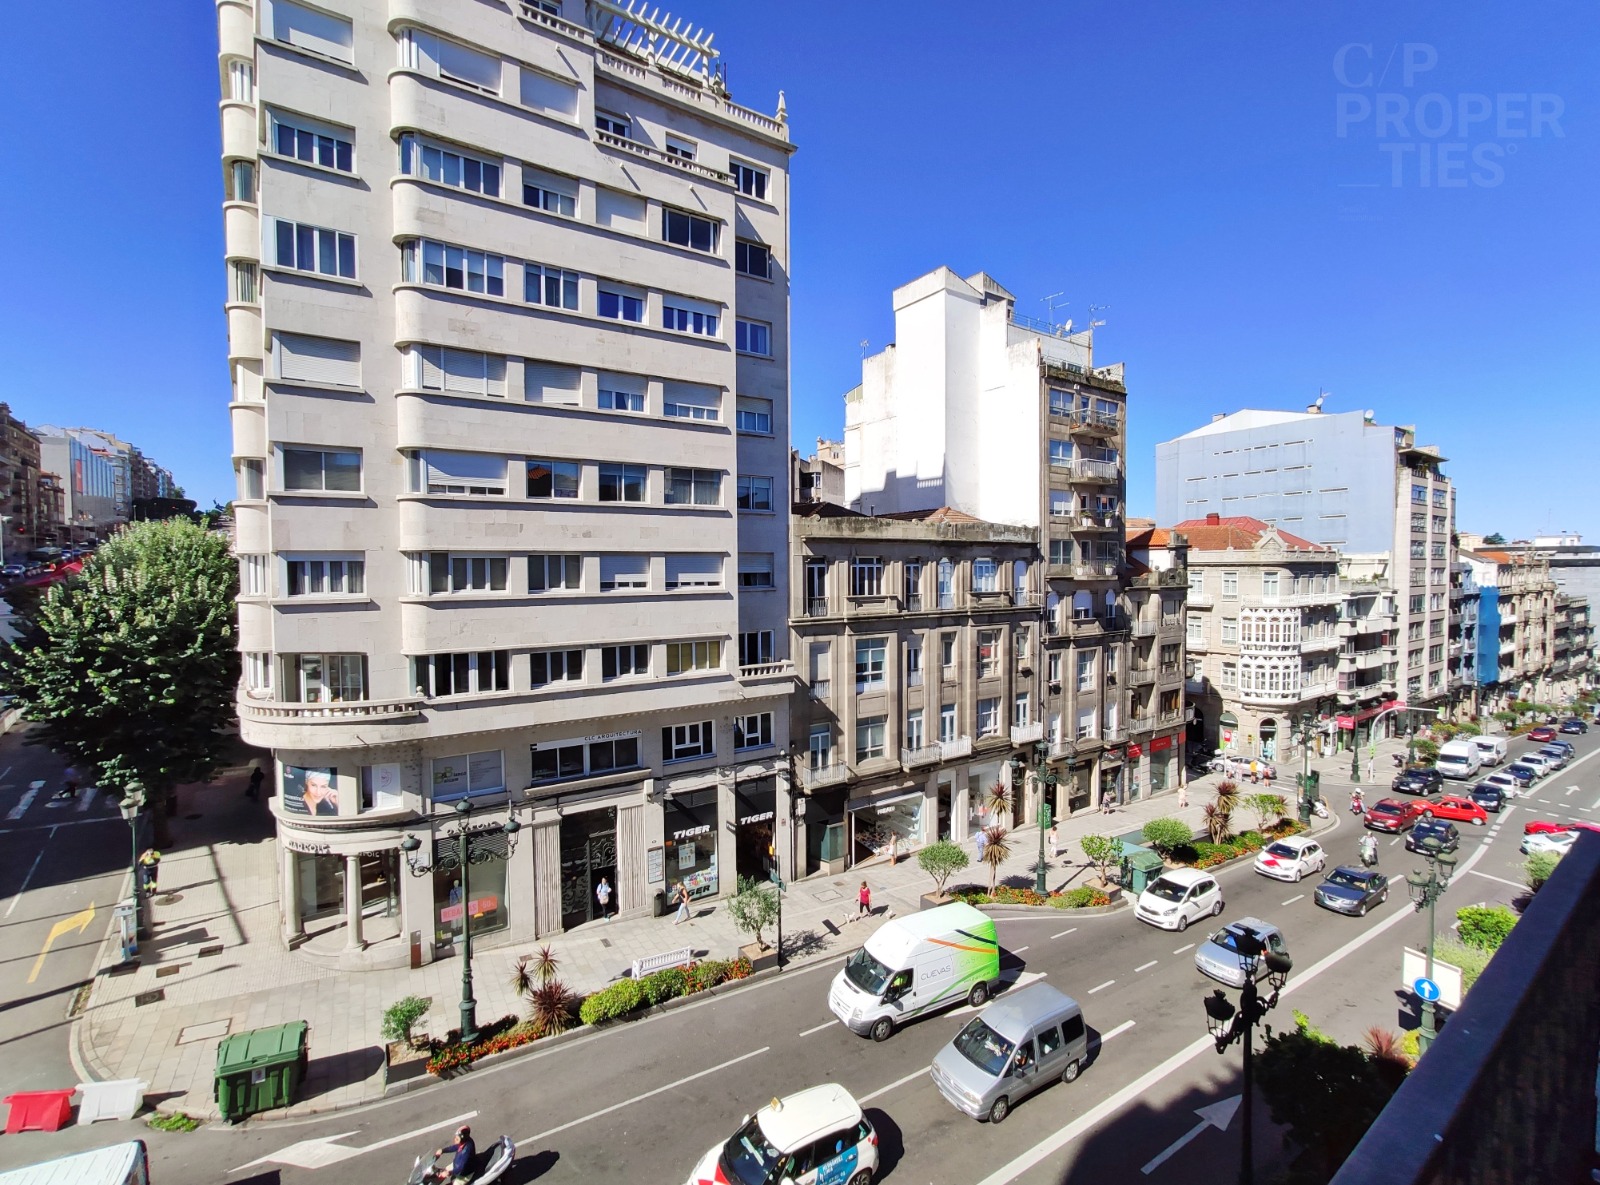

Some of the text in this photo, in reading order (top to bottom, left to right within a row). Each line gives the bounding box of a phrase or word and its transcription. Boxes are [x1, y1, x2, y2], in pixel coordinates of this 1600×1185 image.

[597, 729, 642, 740] ARQUITECTURA
[740, 811, 774, 825] TIGER
[673, 824, 710, 840] TIGER
[921, 965, 951, 981] CUEVAS
